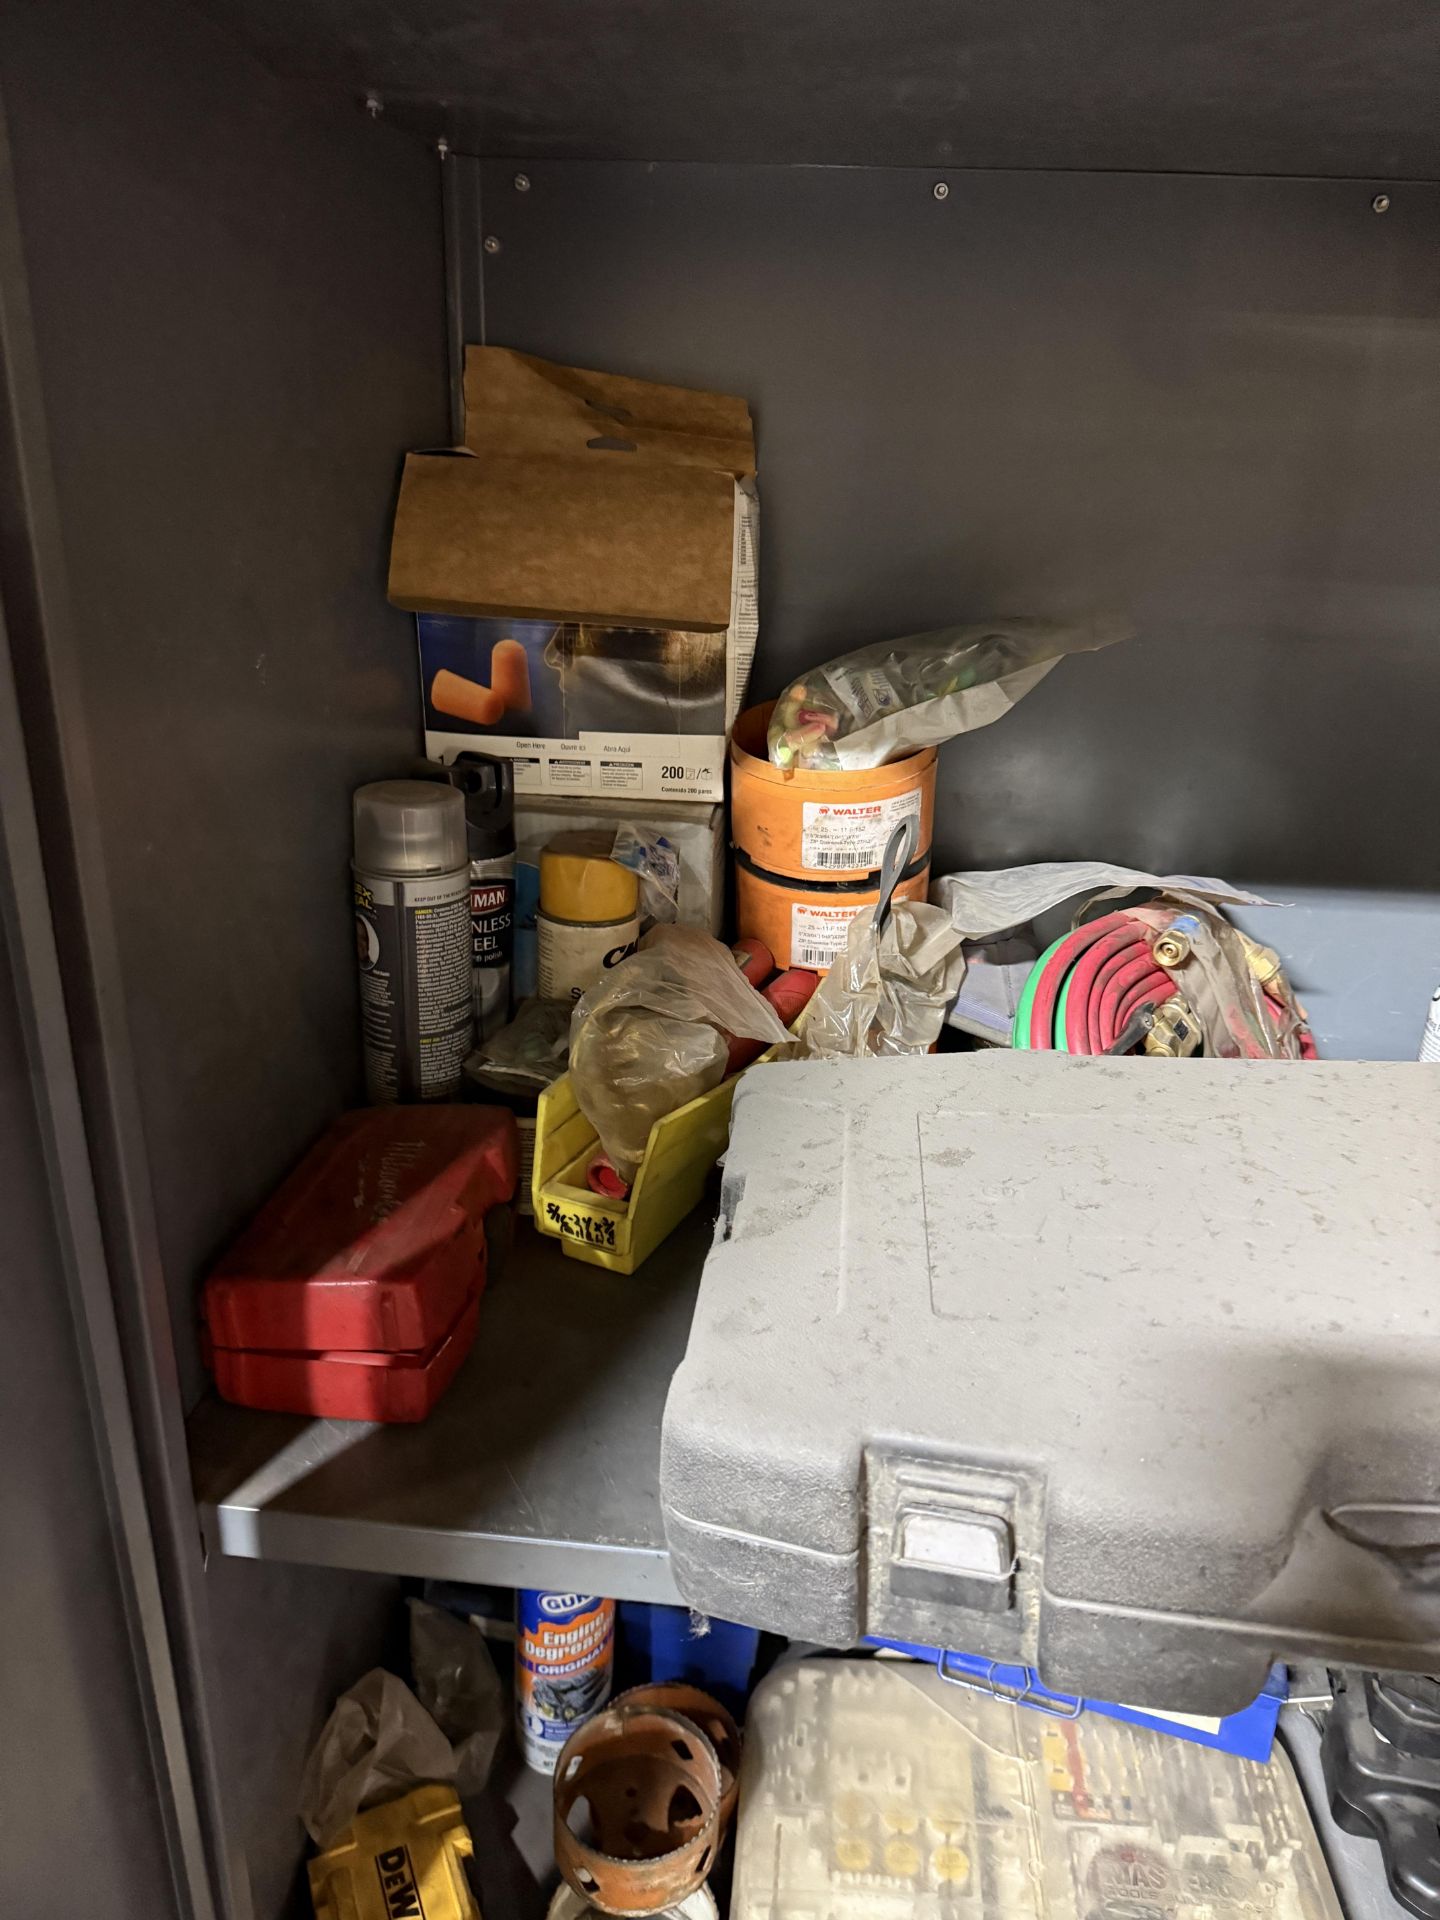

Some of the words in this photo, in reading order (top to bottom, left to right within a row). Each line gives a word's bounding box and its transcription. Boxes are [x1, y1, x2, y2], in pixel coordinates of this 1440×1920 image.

[516, 741, 532, 750] Open
[532, 742, 545, 750] Here
[603, 745, 618, 753] Abra
[661, 766, 684, 780] 200
[833, 805, 881, 815] WALTER
[810, 910, 857, 918] WALTER
[484, 951, 503, 963] polish
[543, 1612, 604, 1646] Engine
